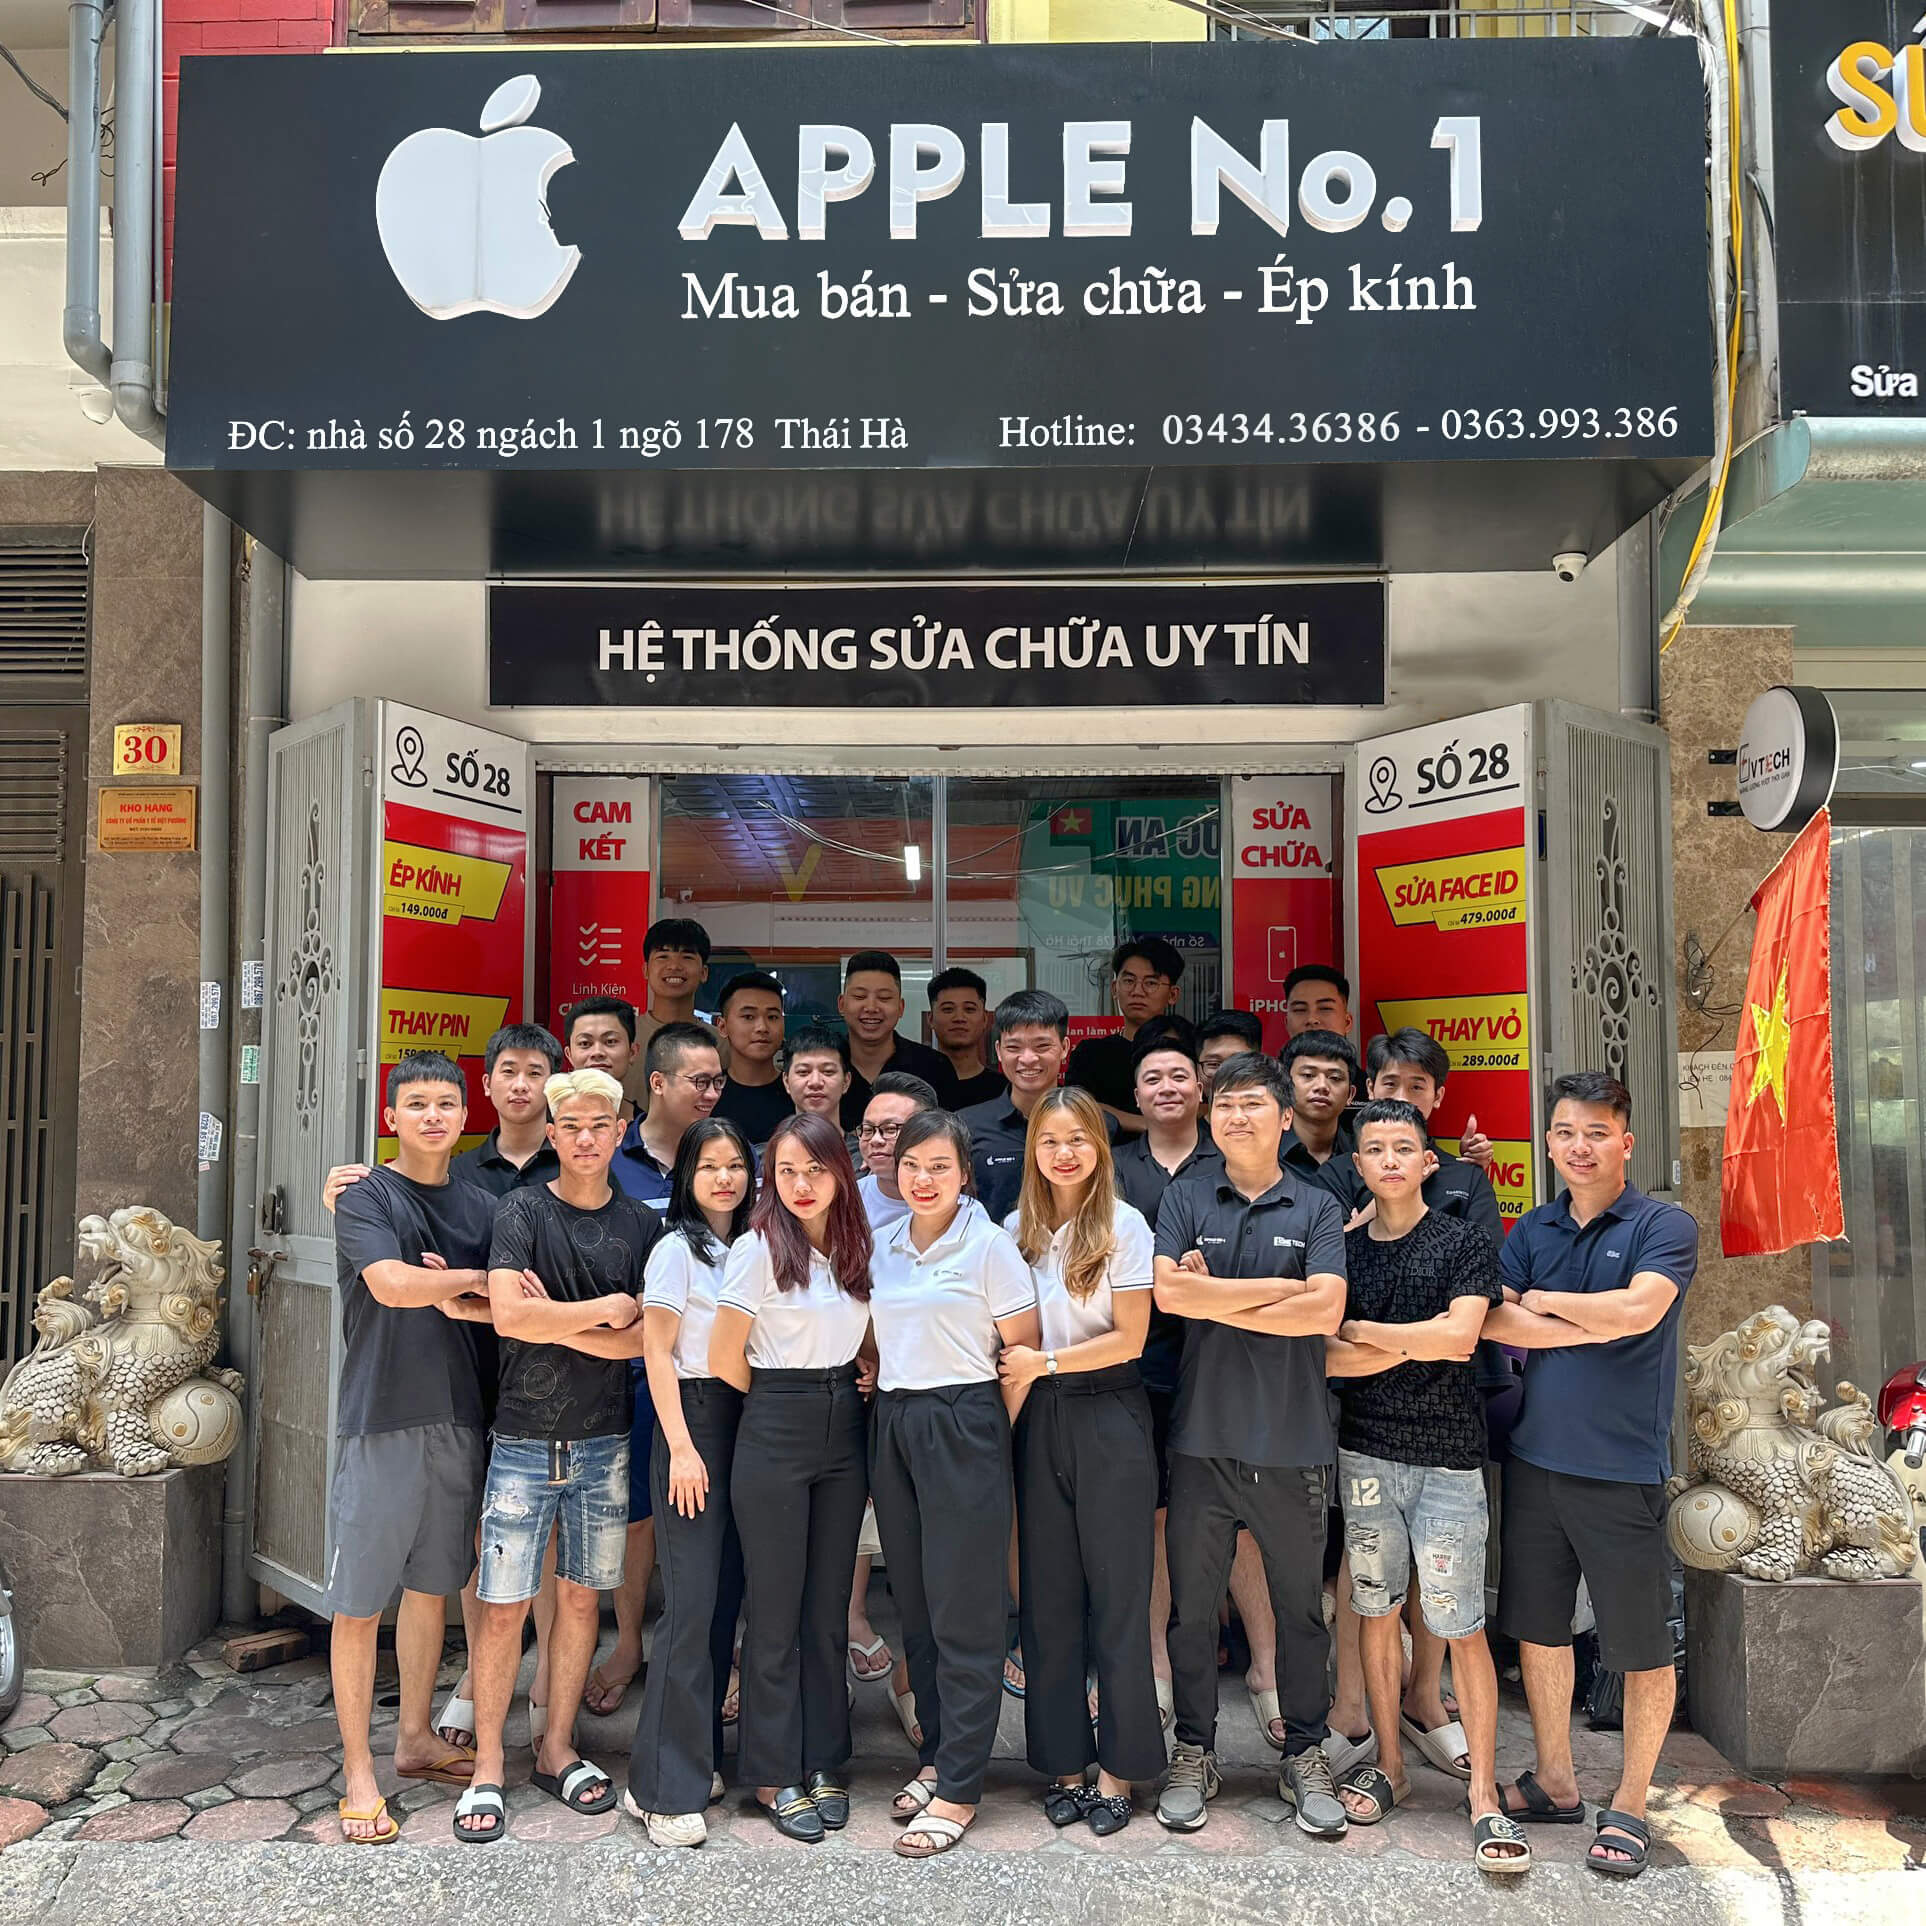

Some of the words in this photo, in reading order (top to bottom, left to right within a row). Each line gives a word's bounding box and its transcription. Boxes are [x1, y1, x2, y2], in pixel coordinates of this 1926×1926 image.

[677, 120, 1134, 242] APPLE
[1190, 115, 1483, 238] No.1
[680, 271, 799, 320] Mua
[816, 269, 912, 319] bán
[929, 293, 947, 304] -
[967, 266, 1064, 317] Sửa
[1083, 266, 1206, 316] chữa
[1223, 290, 1243, 300] -
[1258, 254, 1329, 325] Ép
[1349, 261, 1477, 312] kính
[1850, 363, 1919, 398] Sửa
[226, 420, 296, 451] ĐC:
[306, 419, 368, 450] nhà
[377, 411, 416, 450] số
[425, 419, 466, 450] 28
[476, 418, 580, 457] ngách
[591, 418, 604, 450] 1
[618, 420, 683, 456] ngõ
[696, 418, 755, 449] 178
[774, 416, 852, 449] Thái
[860, 416, 909, 449] Hà
[998, 415, 1136, 448] Hotline:
[1161, 411, 1401, 445] 03434.36386
[1440, 405, 1679, 441] 0363.993.386
[598, 619, 665, 684] HỆ
[672, 614, 857, 671] THỐNG
[869, 614, 974, 671] SỬA
[984, 615, 1134, 670] CHỮA
[1146, 622, 1217, 667] UY
[1224, 613, 1310, 665] TÍN
[122, 735, 168, 764] 30
[446, 749, 479, 788] SỐ
[483, 763, 511, 797] 28
[1417, 739, 1462, 794] SỐ
[1468, 743, 1510, 784] 28
[120, 803, 142, 812] KHO
[573, 801, 632, 823] CAM
[1252, 801, 1311, 830] SỬA
[578, 831, 626, 861] KẾT
[1240, 840, 1323, 868] CHỮA
[390, 858, 415, 888] ÉP
[415, 865, 462, 897] KÍNH
[1394, 875, 1437, 908] SỬA
[1439, 872, 1493, 903] FACE
[1494, 869, 1519, 895] ID
[401, 903, 448, 920] 149.000đ
[1460, 906, 1517, 925] 479.000đ
[572, 983, 598, 995] Linh
[601, 983, 627, 998] Kiện
[388, 1009, 439, 1036] THAY
[439, 1012, 471, 1038] PIN
[1426, 1016, 1485, 1042] THAY
[1487, 1007, 1522, 1041] VỎ
[1461, 1053, 1520, 1067] 289.000đ
[1485, 1160, 1524, 1187] NG
[1350, 1477, 1382, 1507] 12
